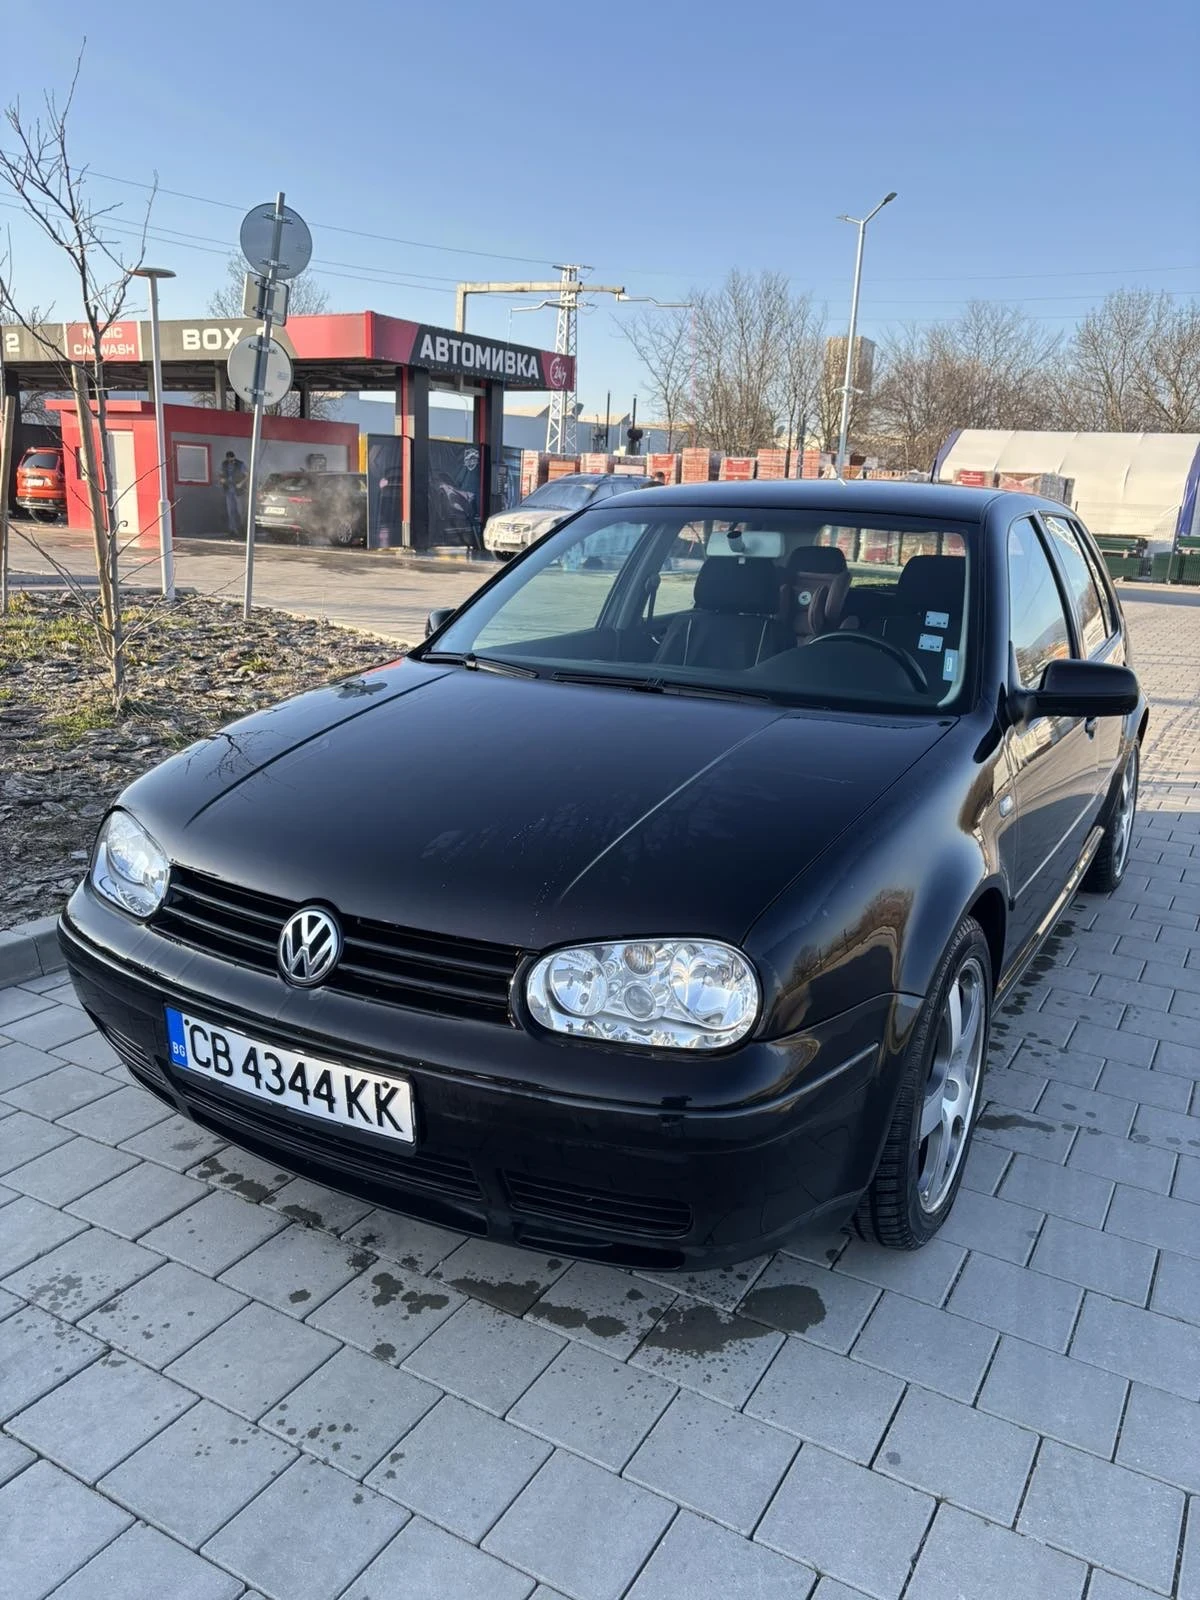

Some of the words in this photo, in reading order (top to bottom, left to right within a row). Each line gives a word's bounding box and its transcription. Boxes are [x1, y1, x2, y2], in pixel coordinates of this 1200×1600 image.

[6, 333, 20, 353] 2
[83, 327, 123, 339] MGIC
[182, 327, 243, 350] BOX
[420, 334, 539, 379] АВТОМИВКА
[172, 1041, 186, 1058] BG
[189, 1024, 234, 1078] CB
[241, 1046, 336, 1114] 4344
[344, 1074, 404, 1133] KK
